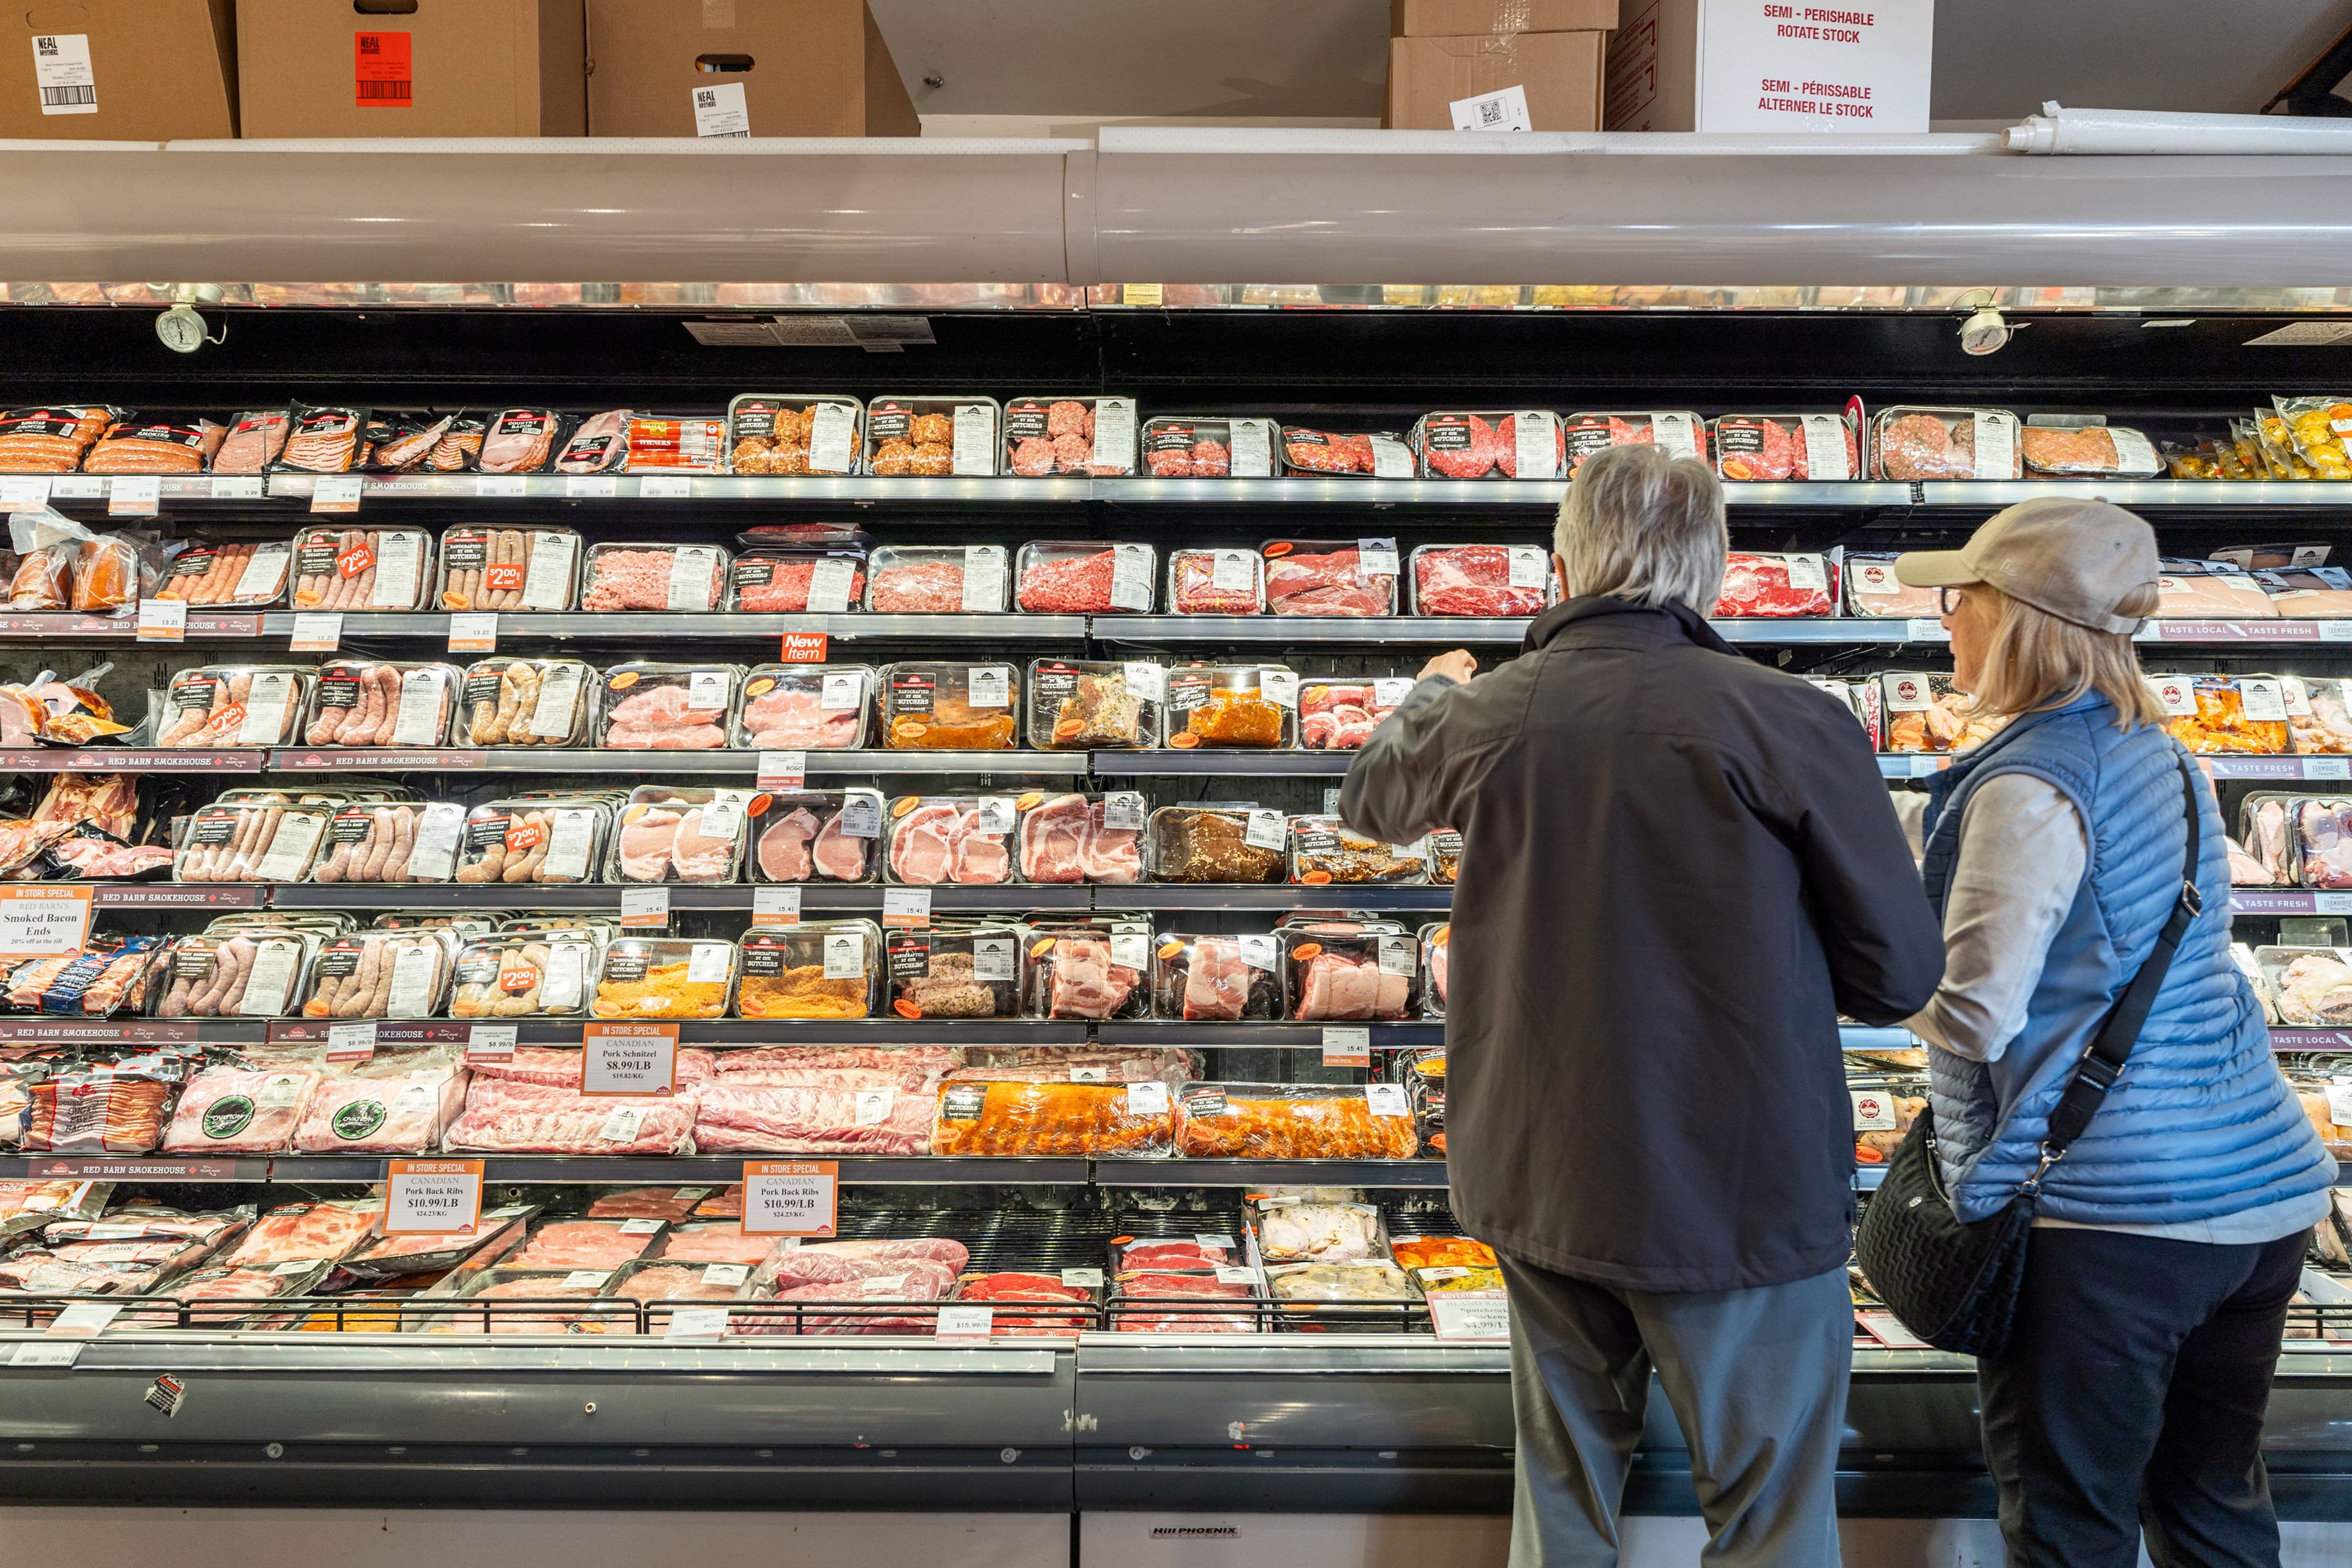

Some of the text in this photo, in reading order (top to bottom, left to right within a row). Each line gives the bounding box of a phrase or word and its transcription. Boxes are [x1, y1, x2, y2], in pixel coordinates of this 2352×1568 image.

[1764, 5, 1874, 26] SEMI PERISHABLE
[1777, 24, 1860, 43] ROTATE STOCK
[38, 37, 57, 49] NEAL
[361, 37, 380, 47] NEAL
[1762, 79, 1871, 99] SEMI PÉRISSABLE
[698, 90, 715, 102] NEAL
[1758, 98, 1873, 118] ALTERNER LE STOCK
[785, 636, 823, 647] New
[788, 650, 820, 659] Item
[230, 715, 241, 725] OFF
[4, 914, 43, 922] Smoked
[896, 1001, 919, 1016] Special
[633, 1027, 661, 1035] SPECIAL
[606, 1061, 650, 1070] $8.99/LB
[408, 1199, 458, 1207] $10.99/LB
